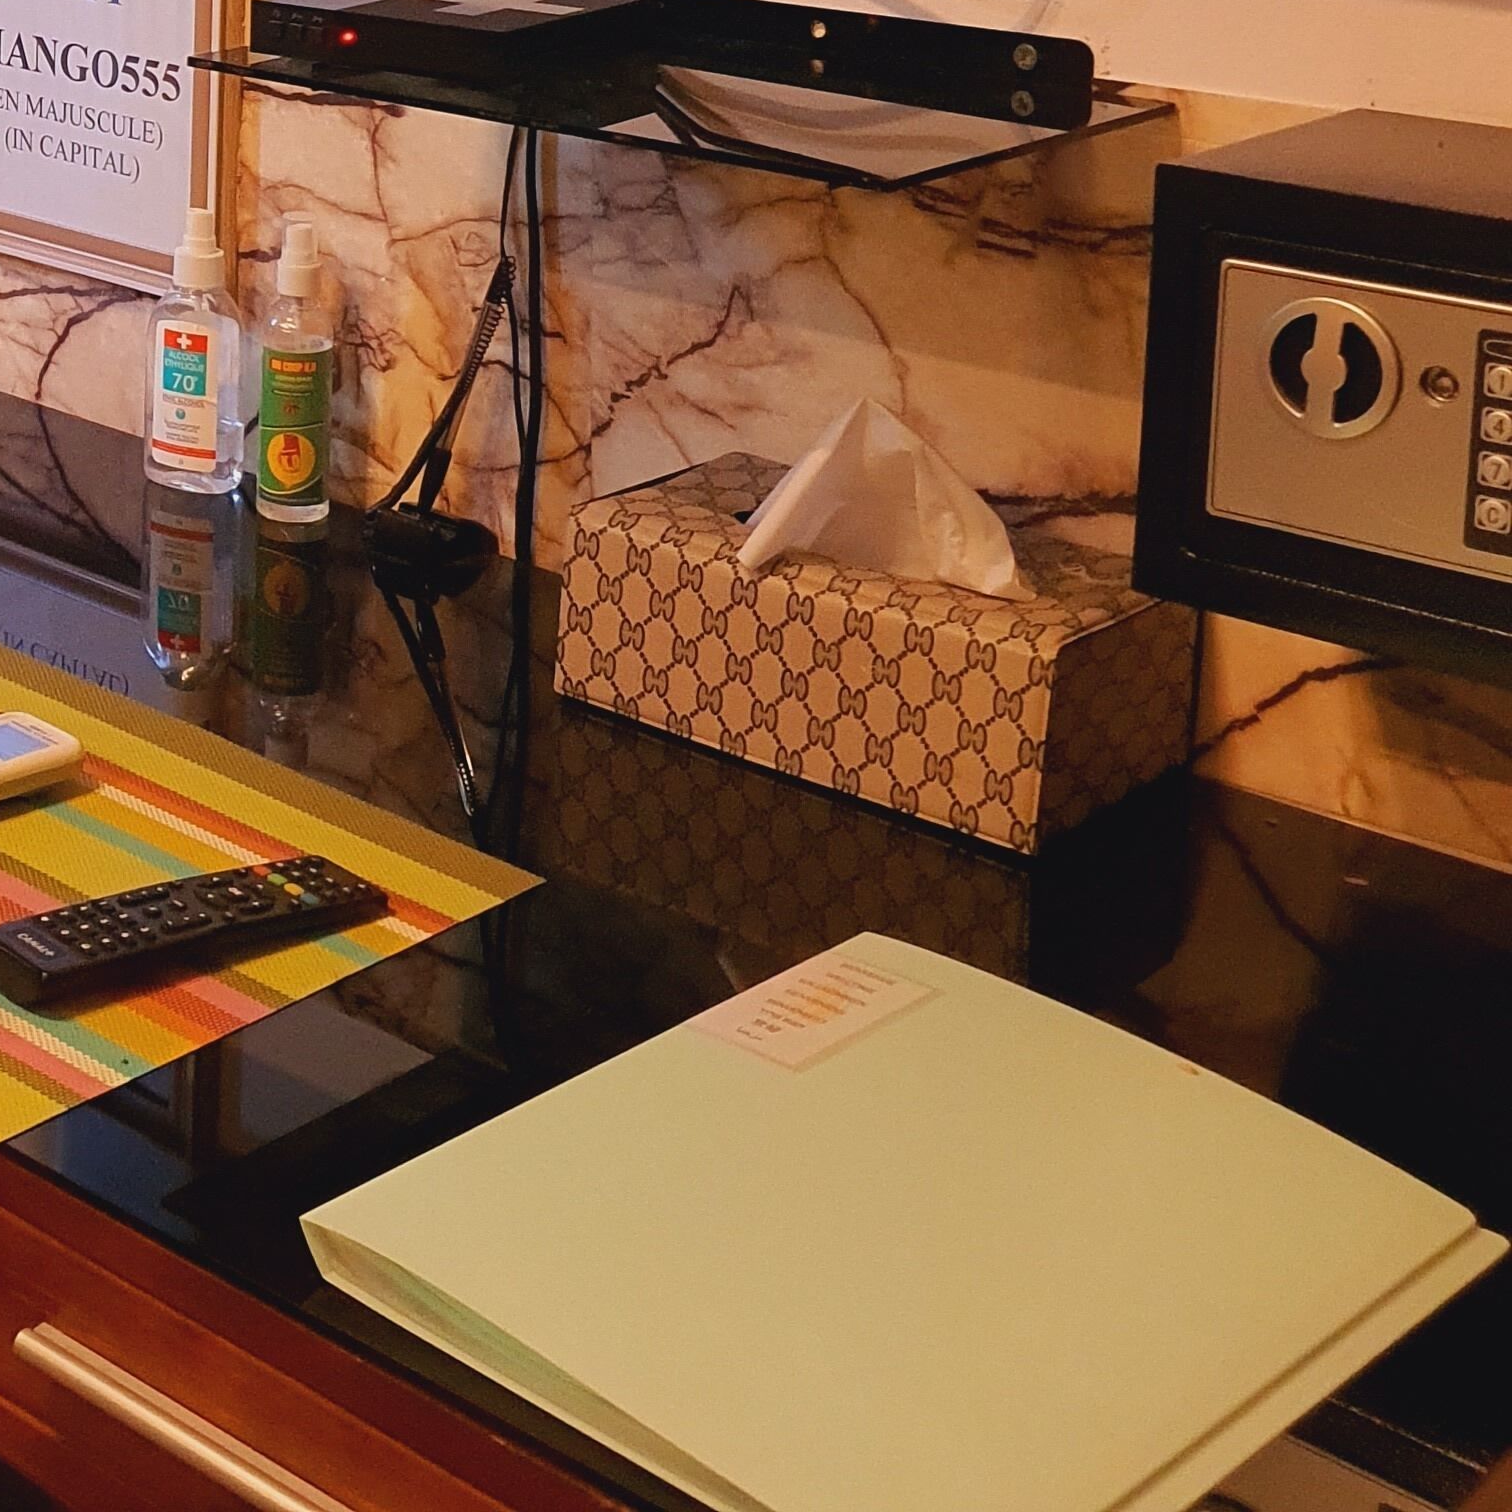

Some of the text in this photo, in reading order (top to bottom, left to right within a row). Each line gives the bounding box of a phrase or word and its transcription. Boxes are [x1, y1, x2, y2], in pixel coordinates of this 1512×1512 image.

[25, 92, 165, 151] MAJUSCULE)
[4, 125, 142, 185] (IN CAPITAL)
[1492, 418, 1504, 437] 4
[1489, 462, 1502, 481] 7
